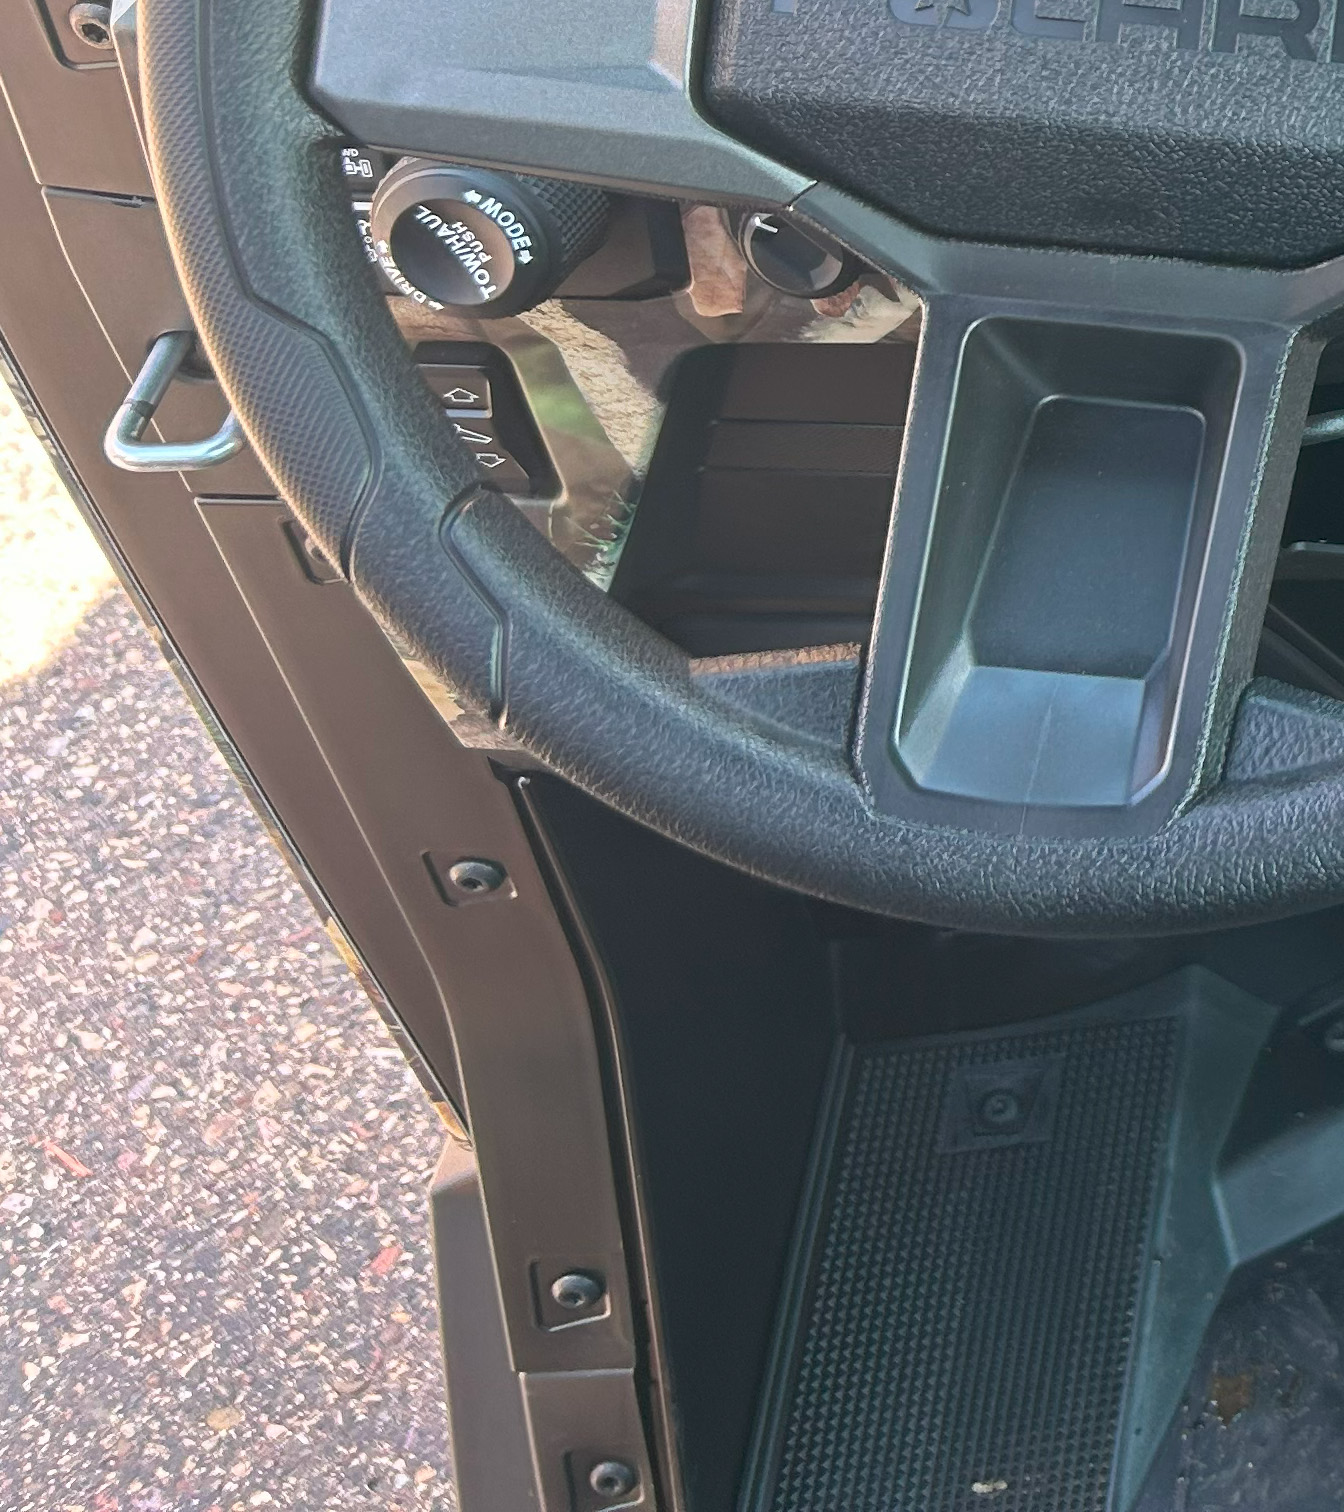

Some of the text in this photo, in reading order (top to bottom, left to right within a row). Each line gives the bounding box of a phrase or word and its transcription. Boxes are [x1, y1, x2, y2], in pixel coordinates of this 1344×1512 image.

[451, 221, 493, 262] PUSH
[480, 196, 532, 251] MODE
[378, 252, 427, 304] DRIVE
[415, 205, 497, 301] TOW/HAUL
